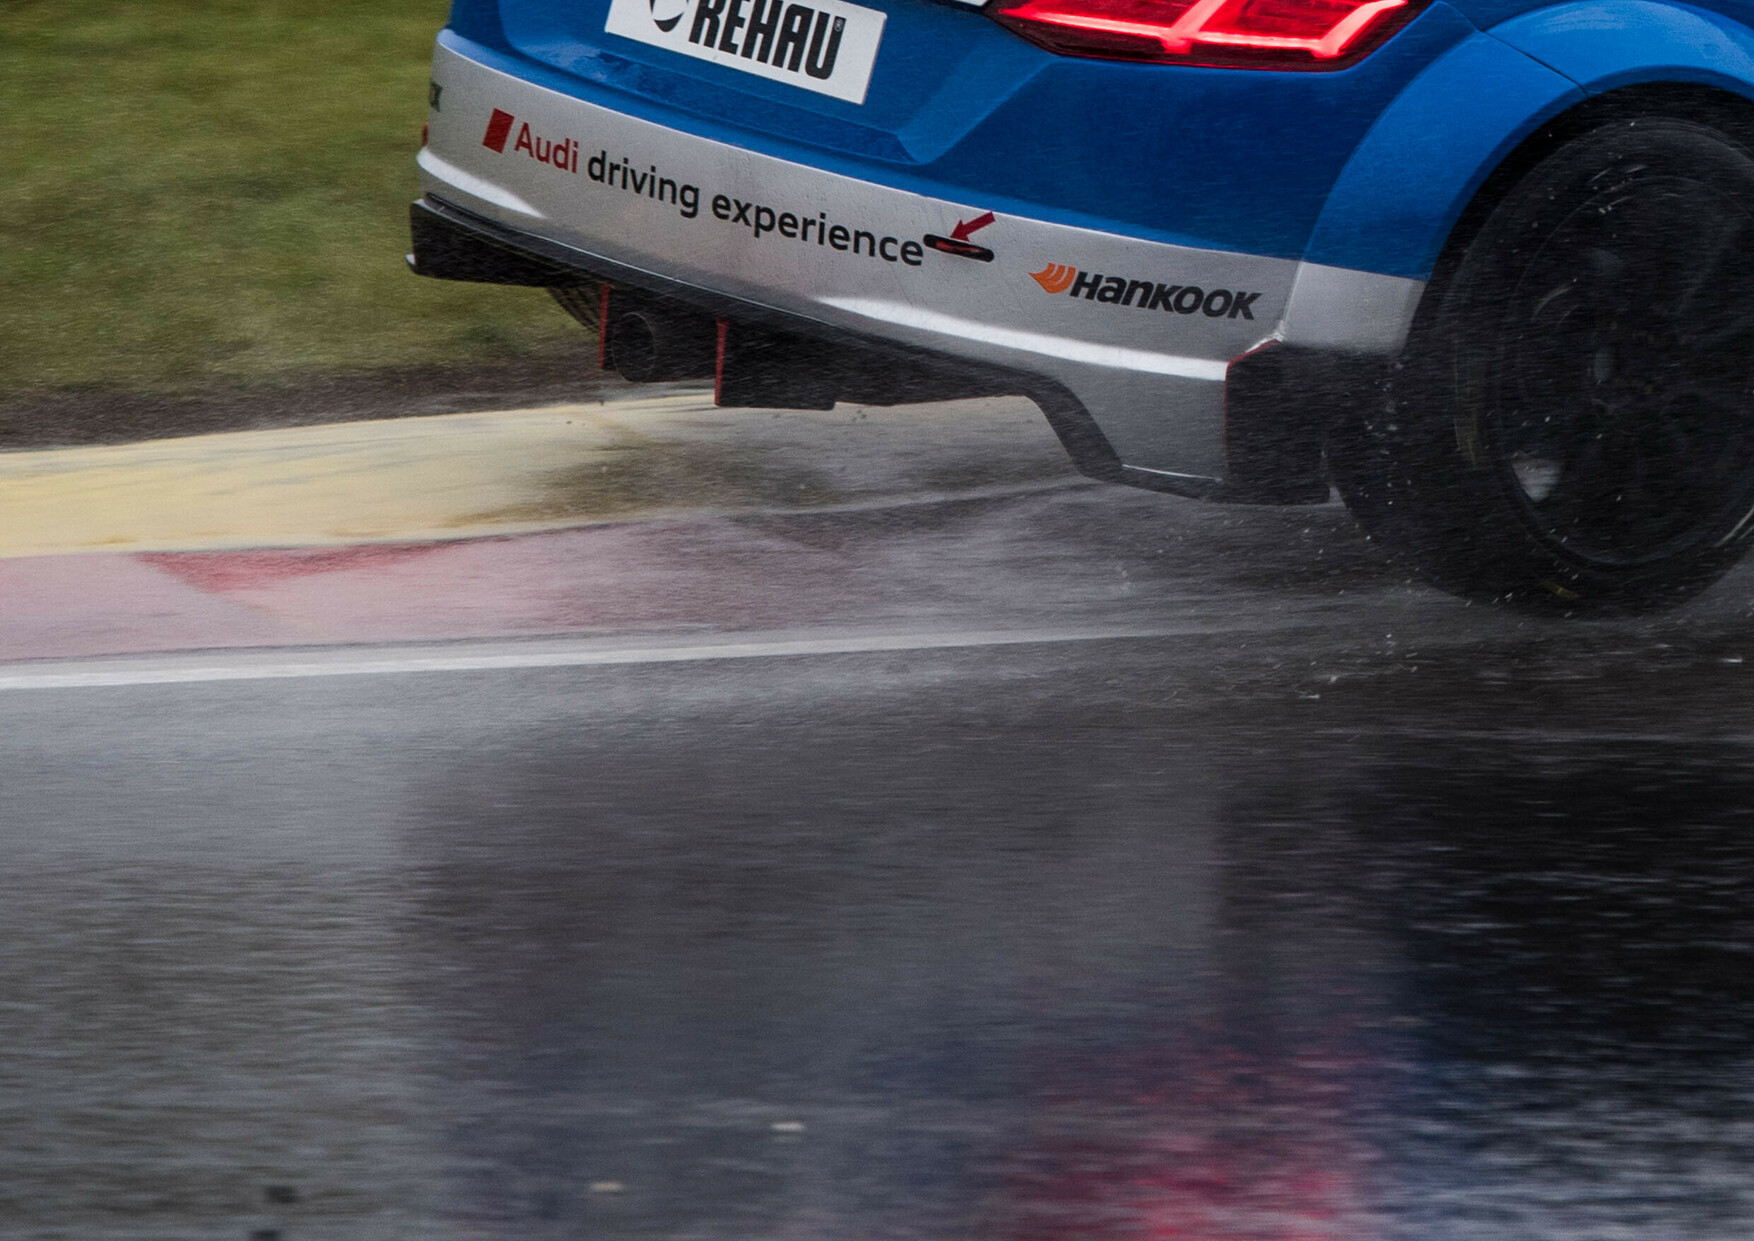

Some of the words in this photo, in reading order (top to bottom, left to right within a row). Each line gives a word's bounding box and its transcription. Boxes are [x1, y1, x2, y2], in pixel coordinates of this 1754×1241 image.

[514, 122, 580, 174] Audi
[587, 150, 701, 219] driving
[711, 193, 925, 266] experience
